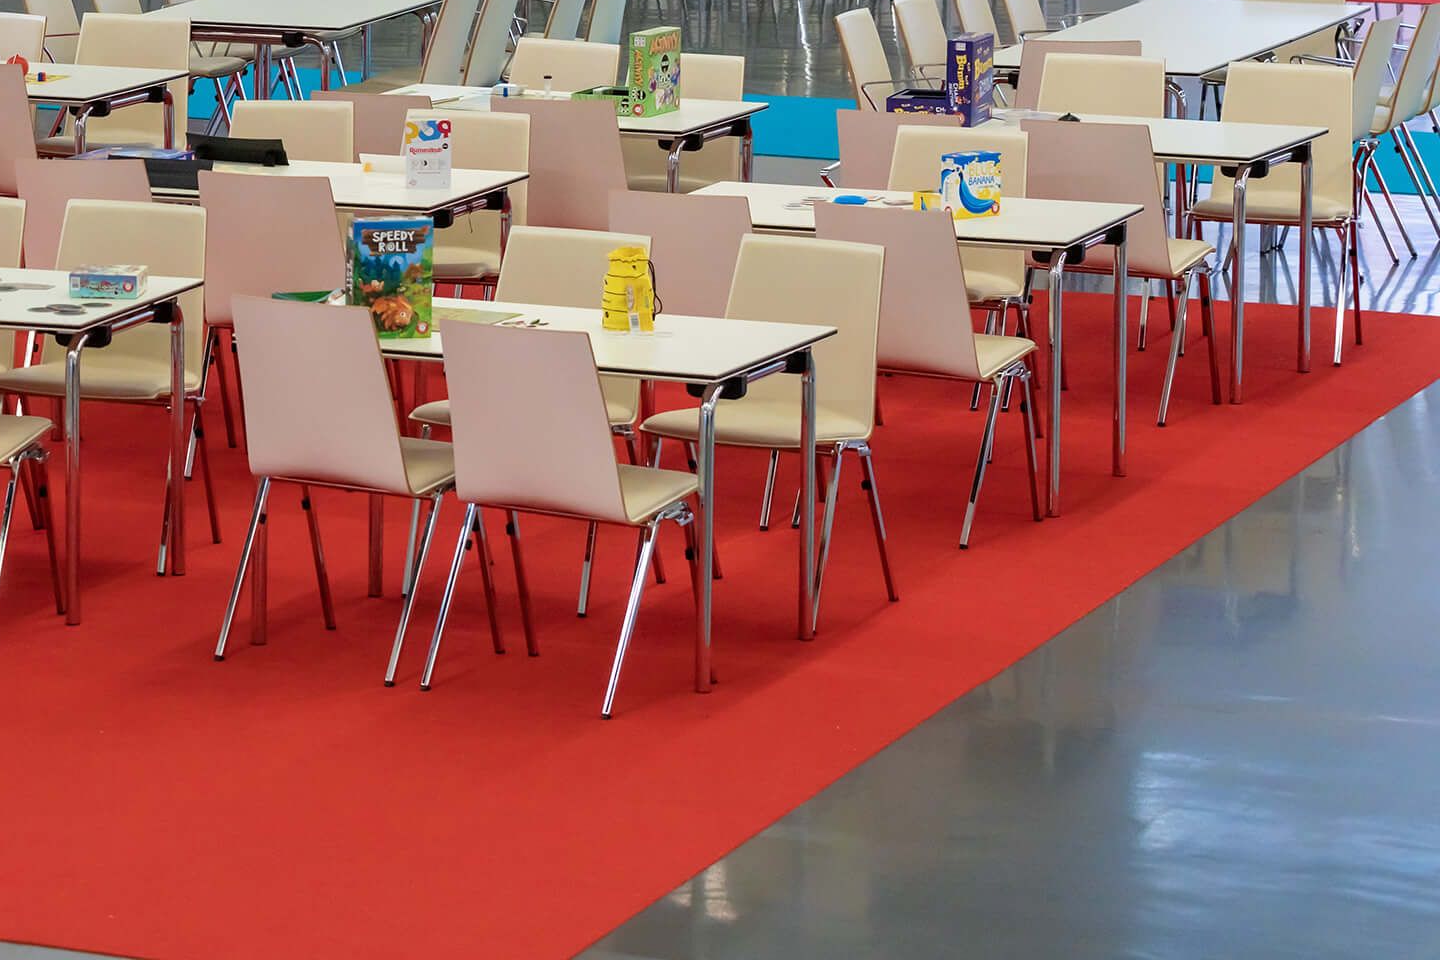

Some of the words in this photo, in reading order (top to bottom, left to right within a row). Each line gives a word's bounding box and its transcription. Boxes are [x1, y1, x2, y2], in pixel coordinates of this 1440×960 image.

[650, 32, 680, 55] ACTIVITY
[956, 54, 968, 90] Bumm
[968, 176, 995, 186] BANANA
[372, 230, 416, 242] SPEEDY
[378, 241, 409, 253] ROLL
